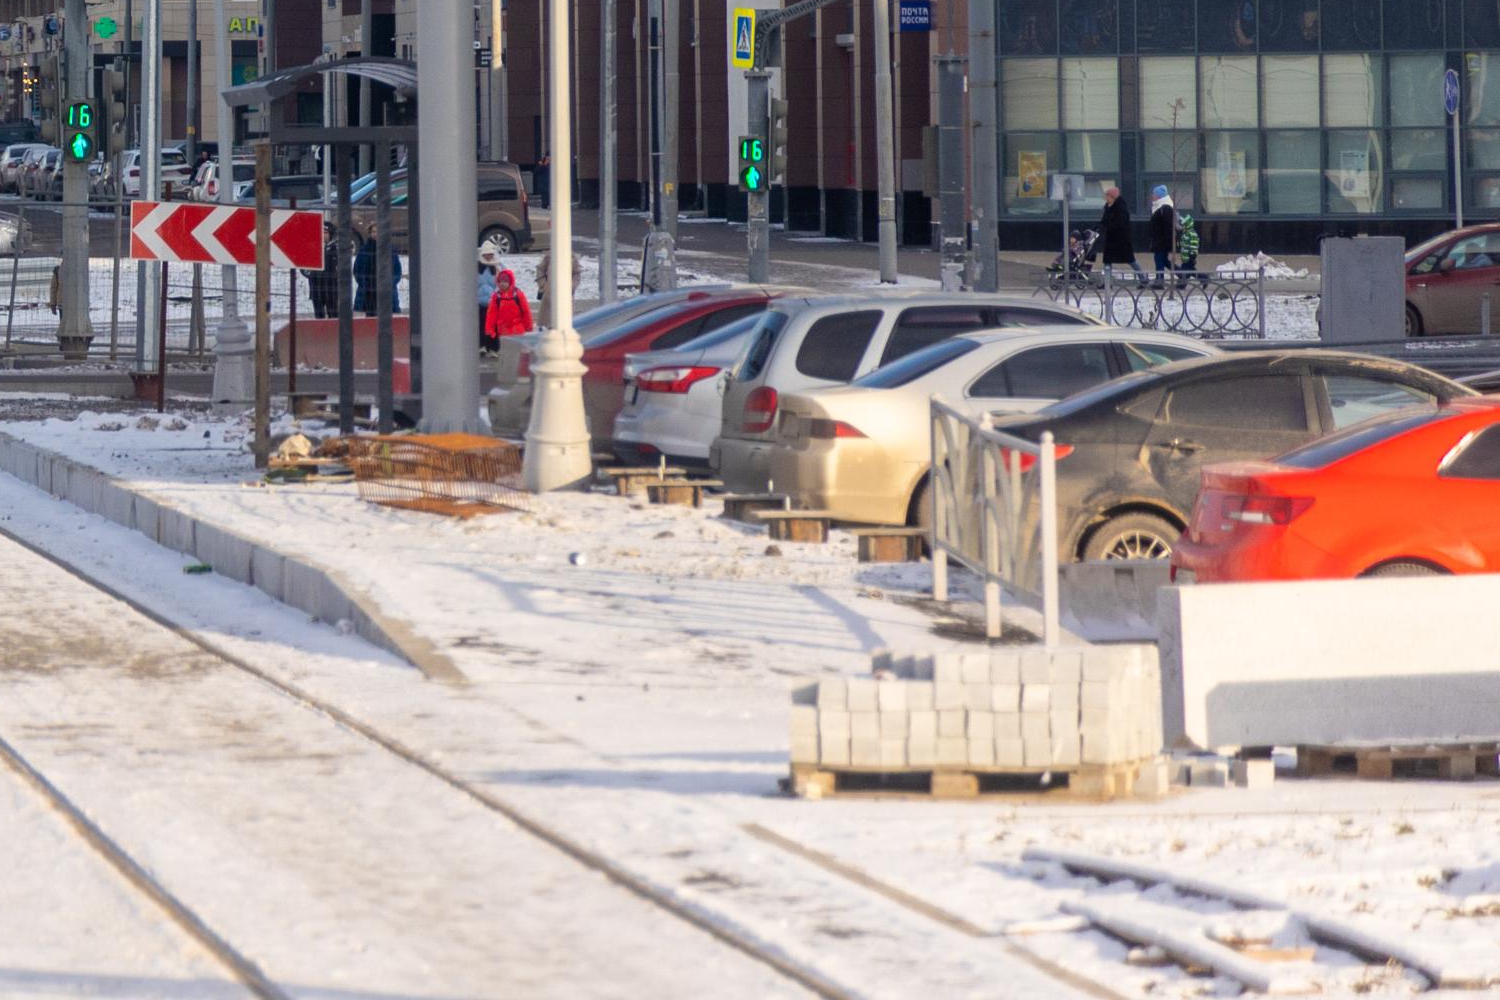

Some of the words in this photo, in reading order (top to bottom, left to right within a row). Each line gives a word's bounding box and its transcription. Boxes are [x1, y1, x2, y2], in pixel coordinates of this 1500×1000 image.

[901, 7, 929, 15] ПОЧТА
[901, 16, 929, 24] РОССИИ
[69, 105, 90, 127] 16
[742, 140, 762, 161] 16
